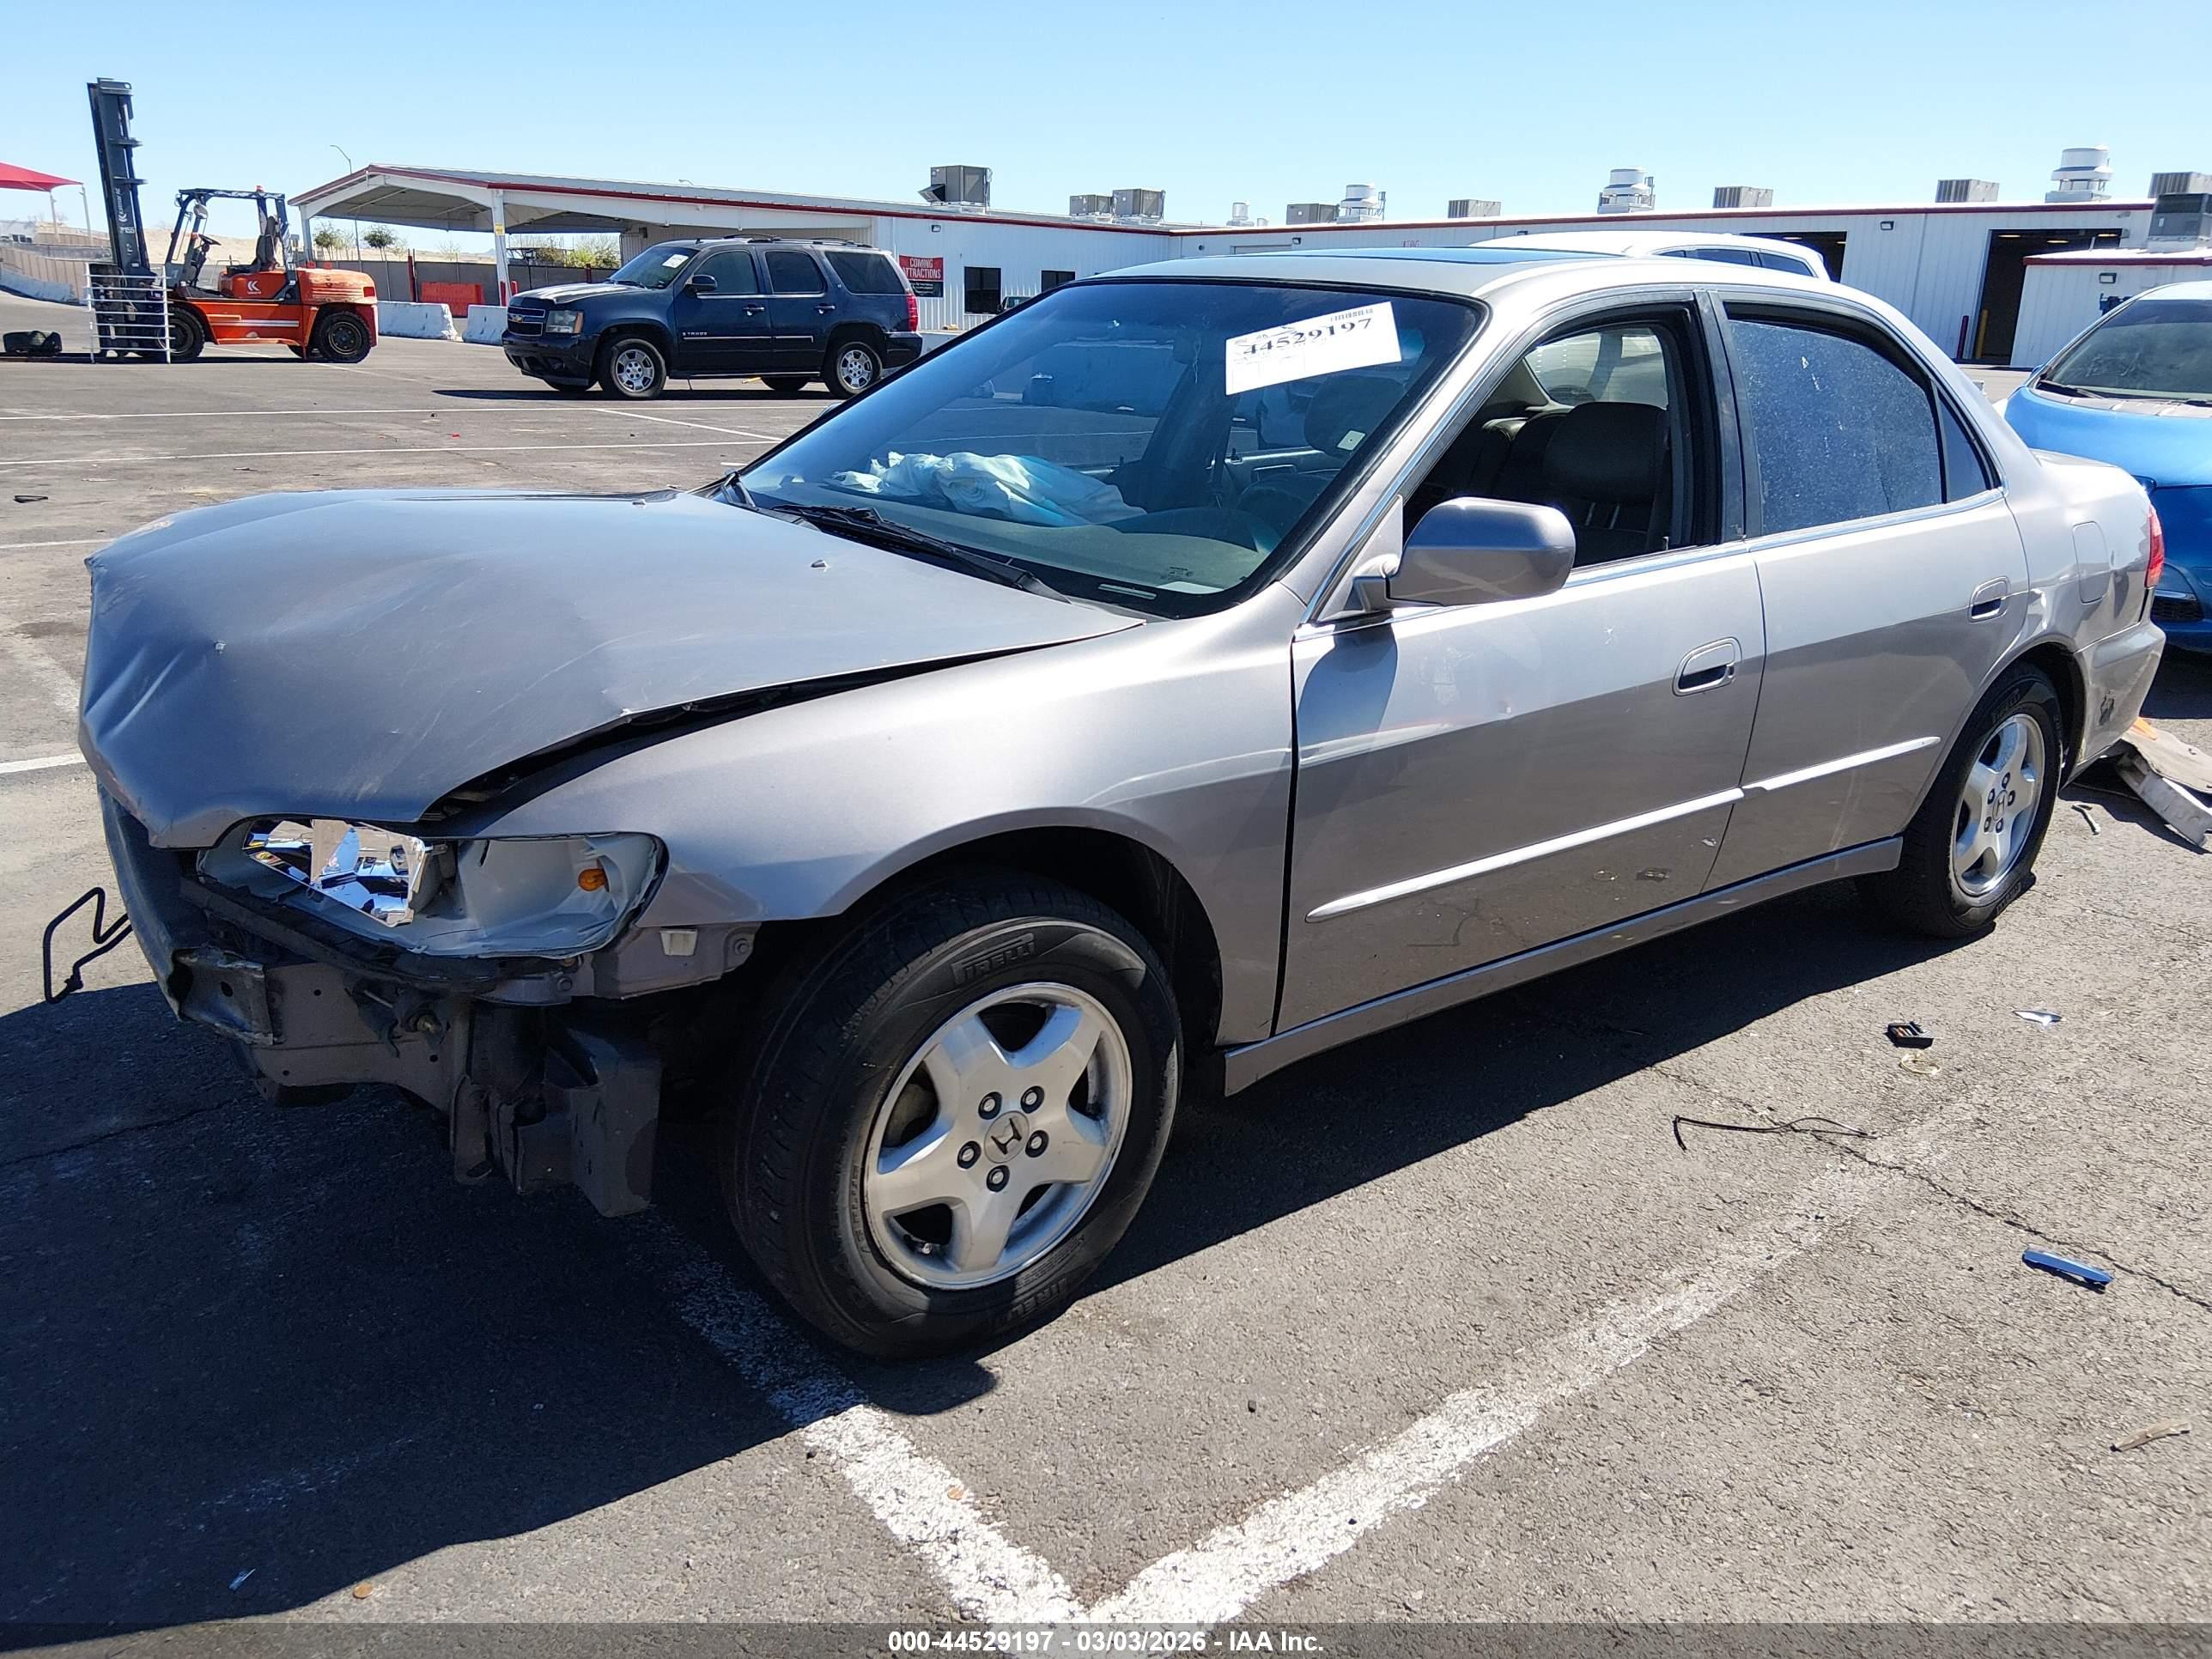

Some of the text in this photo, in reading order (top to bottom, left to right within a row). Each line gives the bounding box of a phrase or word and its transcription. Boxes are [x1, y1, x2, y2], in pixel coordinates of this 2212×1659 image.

[910, 258, 933, 269] COMING
[1243, 319, 1371, 354] 44529197
[951, 932, 1034, 984] PIRELLI
